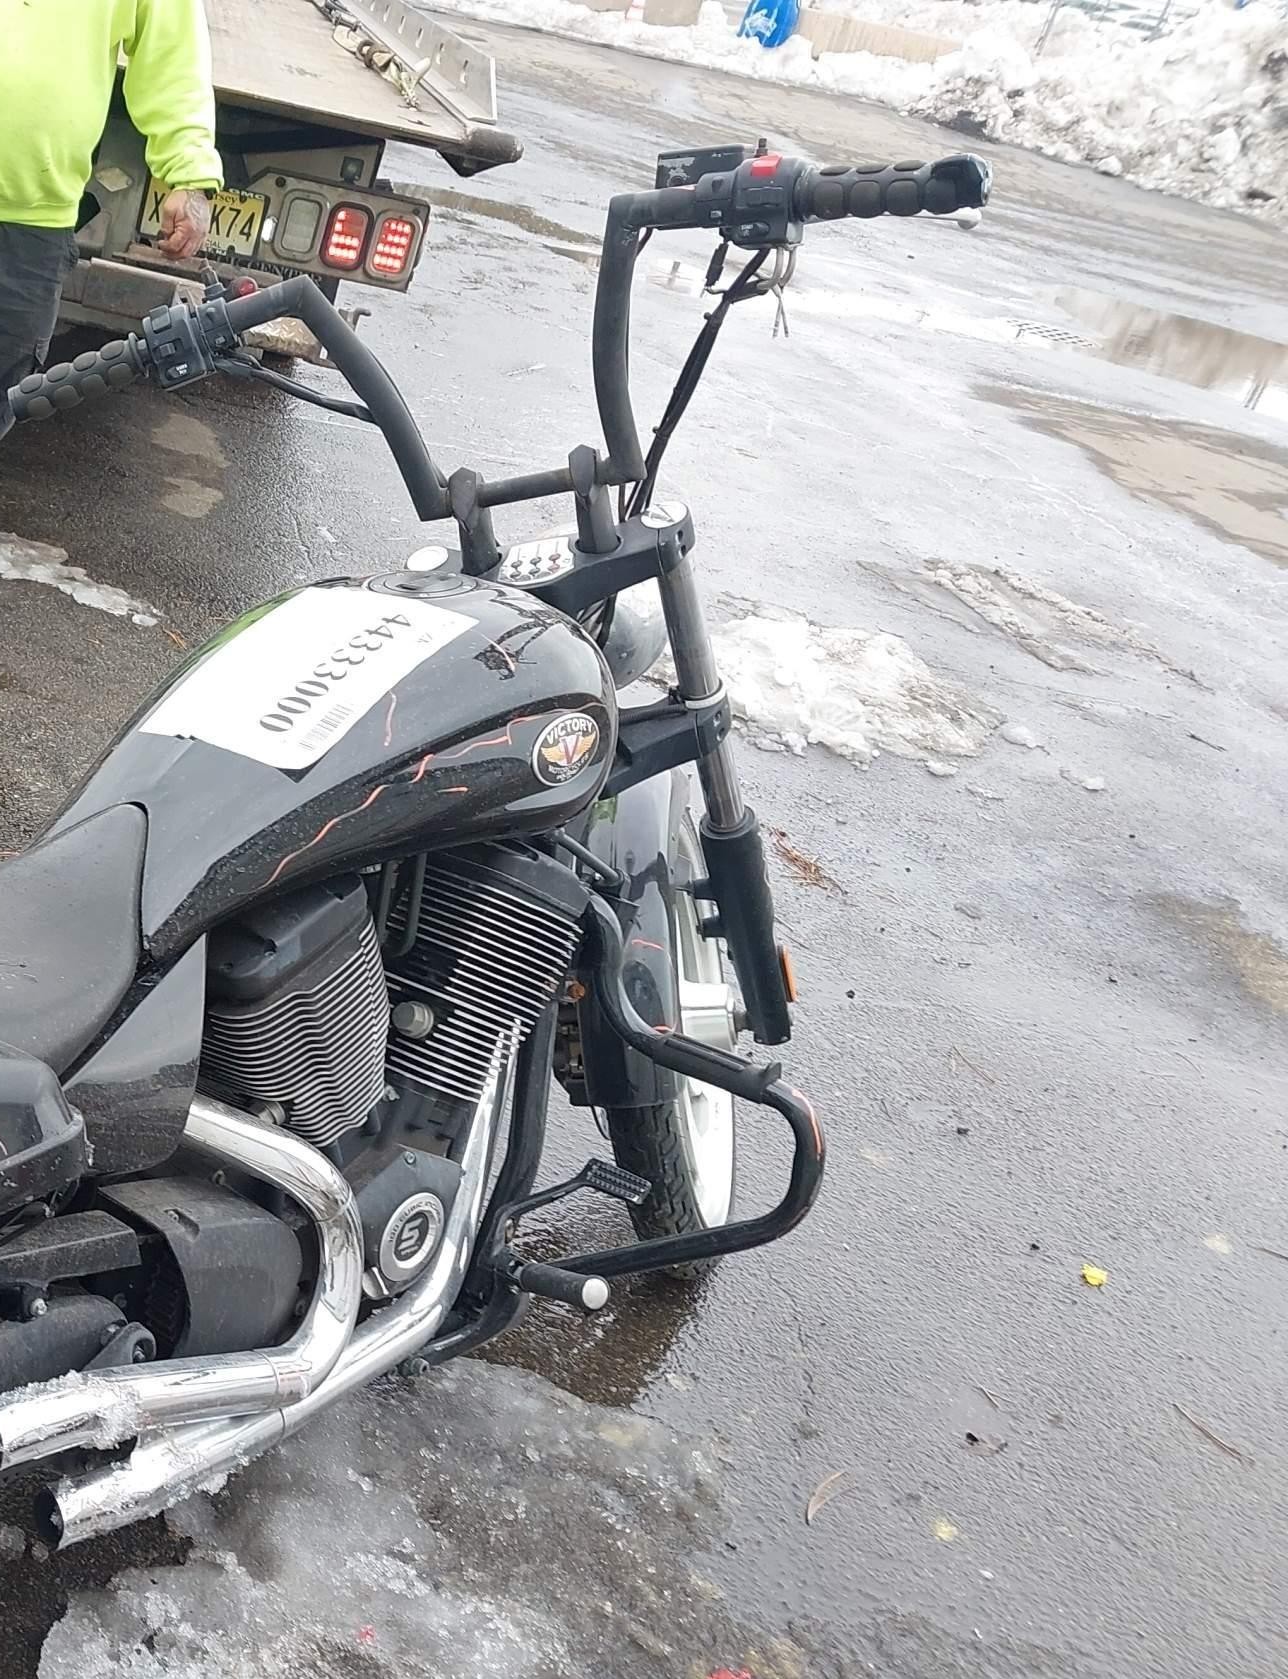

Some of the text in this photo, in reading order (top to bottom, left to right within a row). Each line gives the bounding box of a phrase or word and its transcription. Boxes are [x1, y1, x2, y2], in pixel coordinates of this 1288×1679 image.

[229, 188, 265, 200] GMC
[259, 614, 412, 732] 44333000
[546, 718, 593, 745] VICTORY
